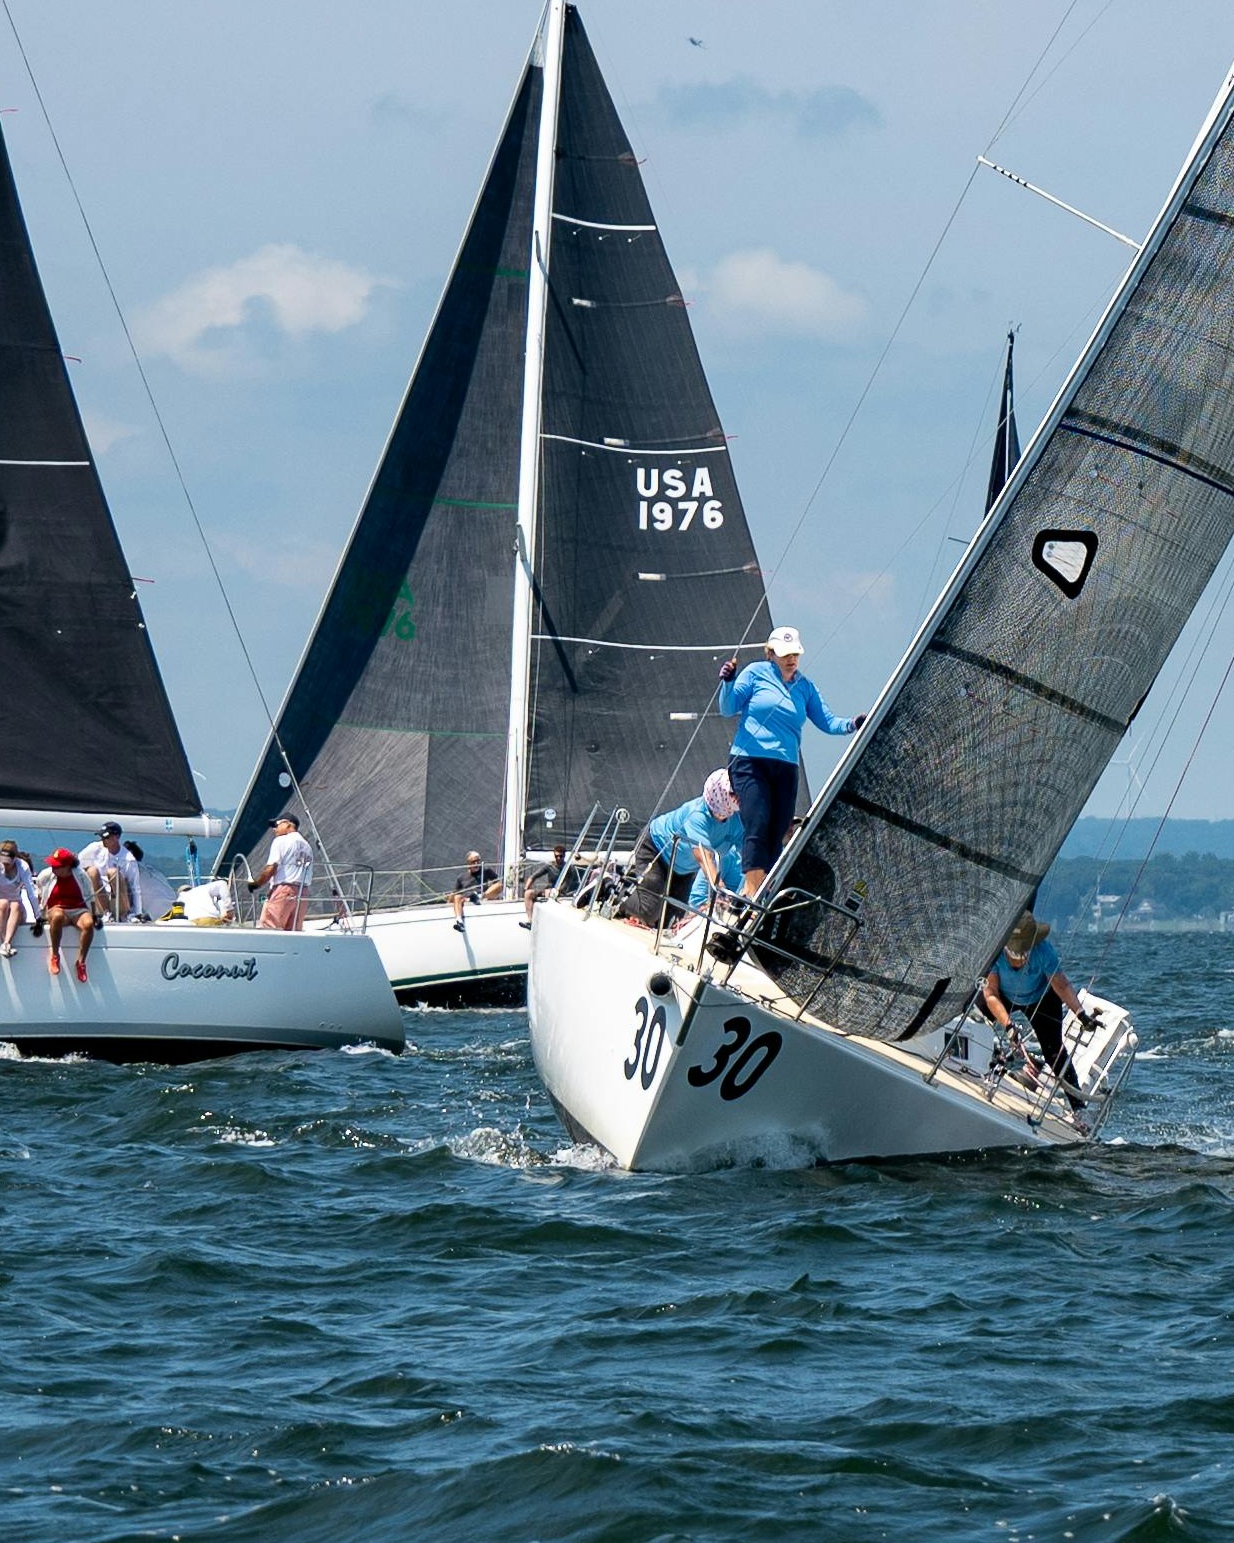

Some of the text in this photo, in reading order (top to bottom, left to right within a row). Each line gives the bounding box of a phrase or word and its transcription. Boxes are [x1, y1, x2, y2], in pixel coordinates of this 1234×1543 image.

[636, 467, 714, 498] USA
[639, 499, 724, 532] 1976
[161, 952, 259, 981] Coconut
[624, 996, 667, 1091] 30
[687, 1016, 783, 1101] 30
